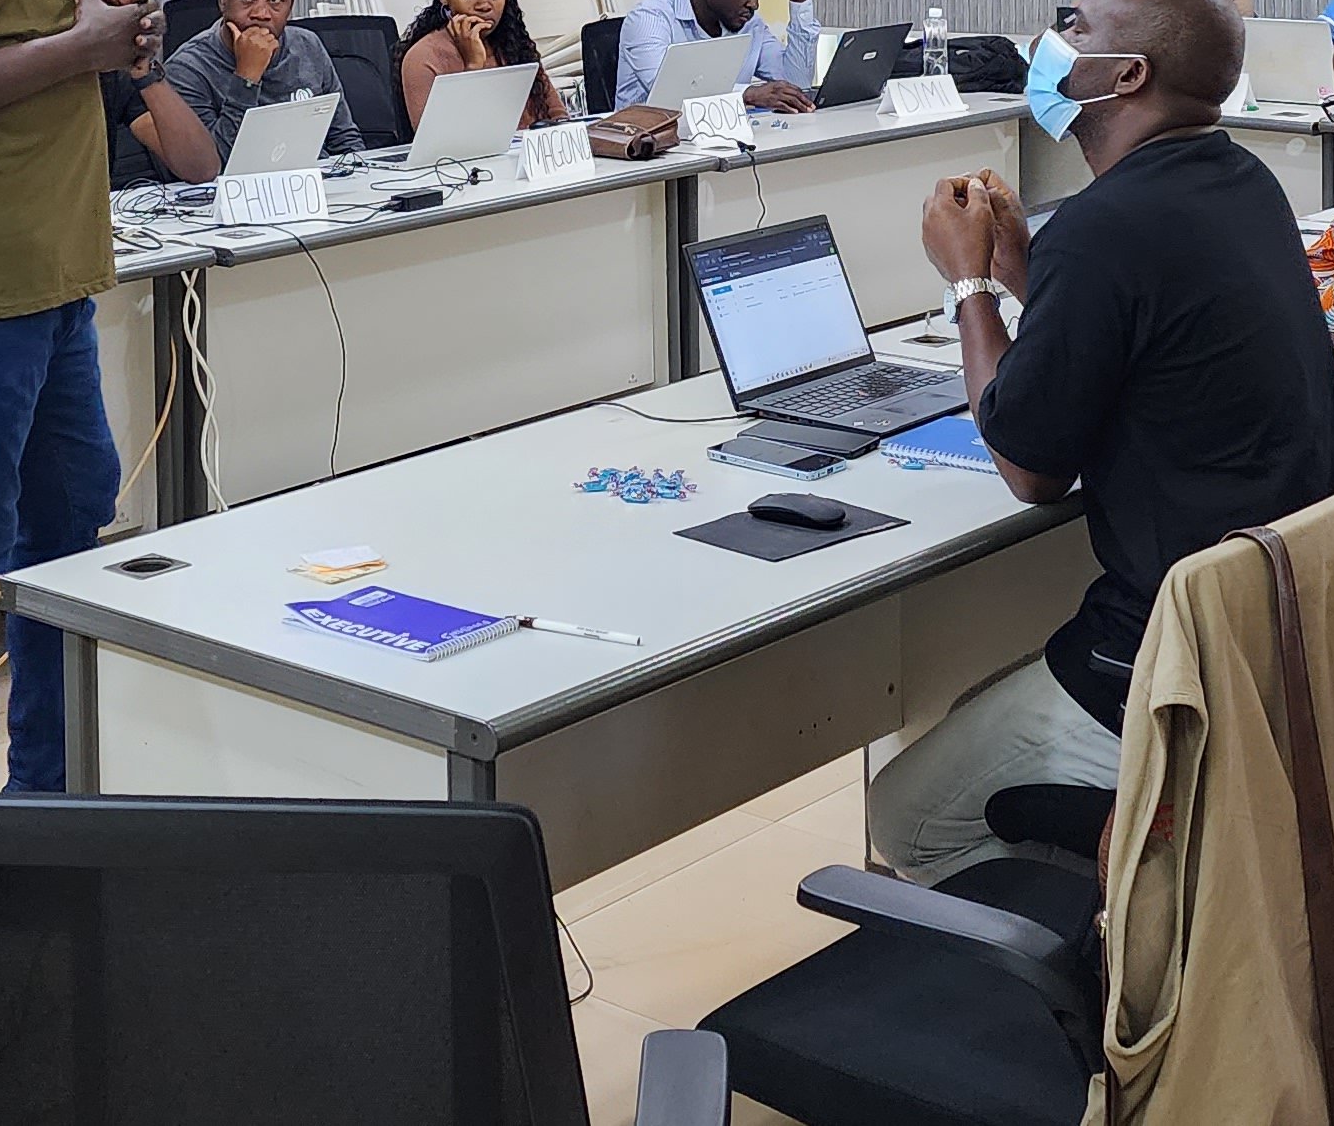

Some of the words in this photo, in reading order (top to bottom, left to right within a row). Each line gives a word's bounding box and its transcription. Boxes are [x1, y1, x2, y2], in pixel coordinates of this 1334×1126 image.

[898, 81, 951, 112] DIMI
[691, 98, 747, 138] RODA
[225, 174, 320, 223] PHILIPO
[300, 608, 433, 651] EXECUTIVE
